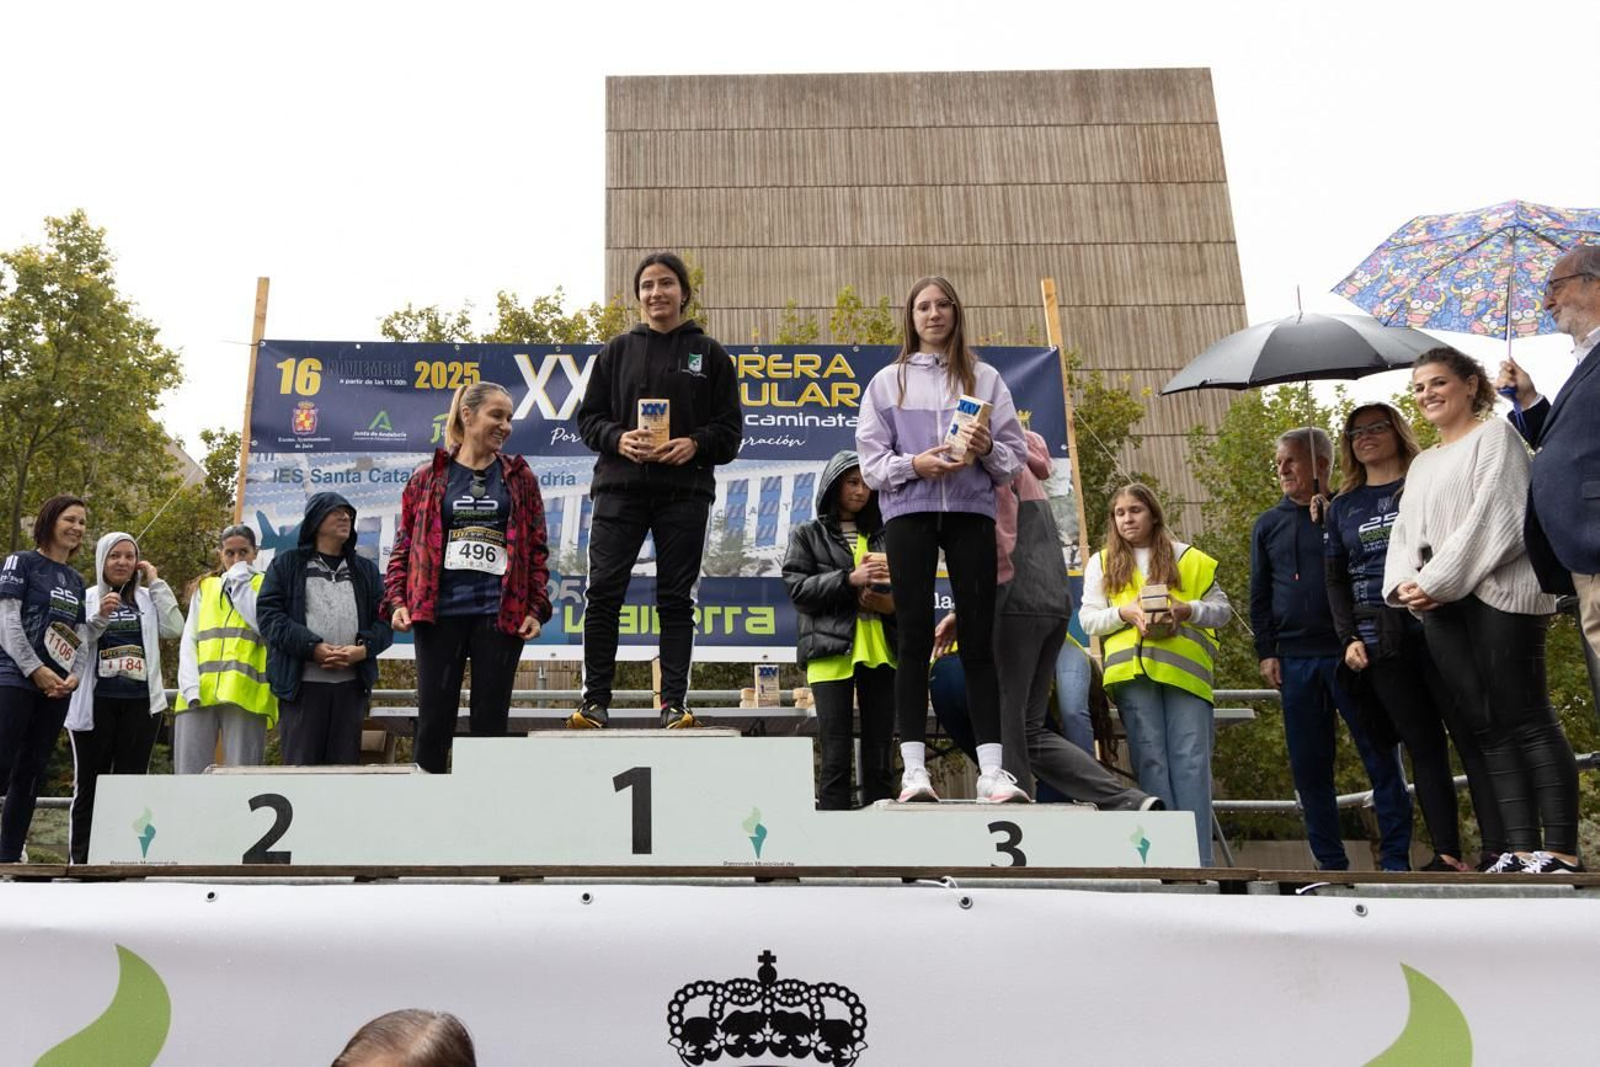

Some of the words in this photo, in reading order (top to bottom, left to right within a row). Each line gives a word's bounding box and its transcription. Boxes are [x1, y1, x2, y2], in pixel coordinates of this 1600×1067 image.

[276, 357, 323, 396] 16
[414, 361, 480, 389] 2025
[729, 353, 855, 378] RERA
[513, 354, 597, 420] XX
[740, 382, 861, 407] ULAR
[641, 403, 667, 416] XXV
[738, 434, 805, 453] gración
[273, 468, 304, 484] IES
[310, 468, 361, 484] Santa
[368, 467, 414, 483] Cata
[538, 471, 577, 487] dría
[1358, 511, 1399, 533] 25
[459, 543, 497, 563] 496
[50, 586, 79, 605] 25
[108, 610, 138, 621] 25
[612, 766, 652, 854] 1
[242, 793, 294, 864] 2
[987, 820, 1027, 867] 3
